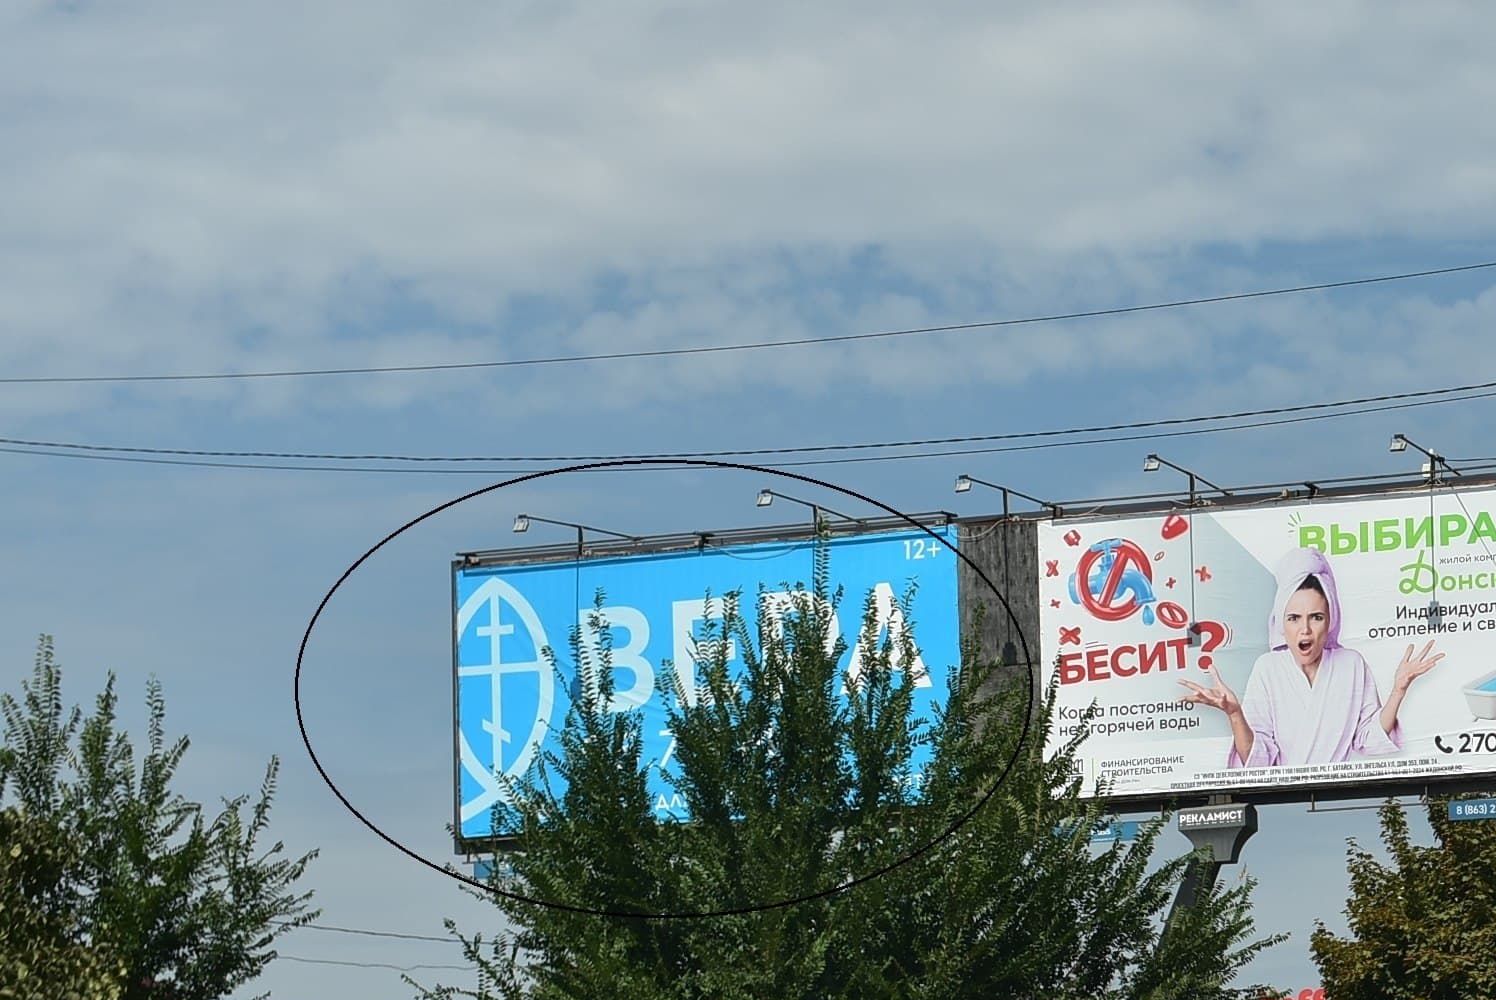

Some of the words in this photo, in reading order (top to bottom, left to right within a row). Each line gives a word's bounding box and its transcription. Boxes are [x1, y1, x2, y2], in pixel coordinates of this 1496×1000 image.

[903, 538, 942, 561] 12+
[1439, 554, 1472, 565] жилой
[1368, 621, 1458, 639] отопление
[1462, 620, 1472, 632] и
[1060, 620, 1226, 686] БЕСИТ?
[1109, 700, 1194, 717] постоянно
[1090, 717, 1155, 736] горячей
[1159, 716, 1200, 730] воды
[1100, 755, 1185, 769] ФИНАНСИРОВАНИЕ
[1101, 766, 1174, 777] СТРОИТЕЛЬСТВА
[1179, 809, 1243, 824] РЕКЛАМИСТ
[1456, 805, 1463, 816] 8
[1464, 804, 1488, 816] (863)
